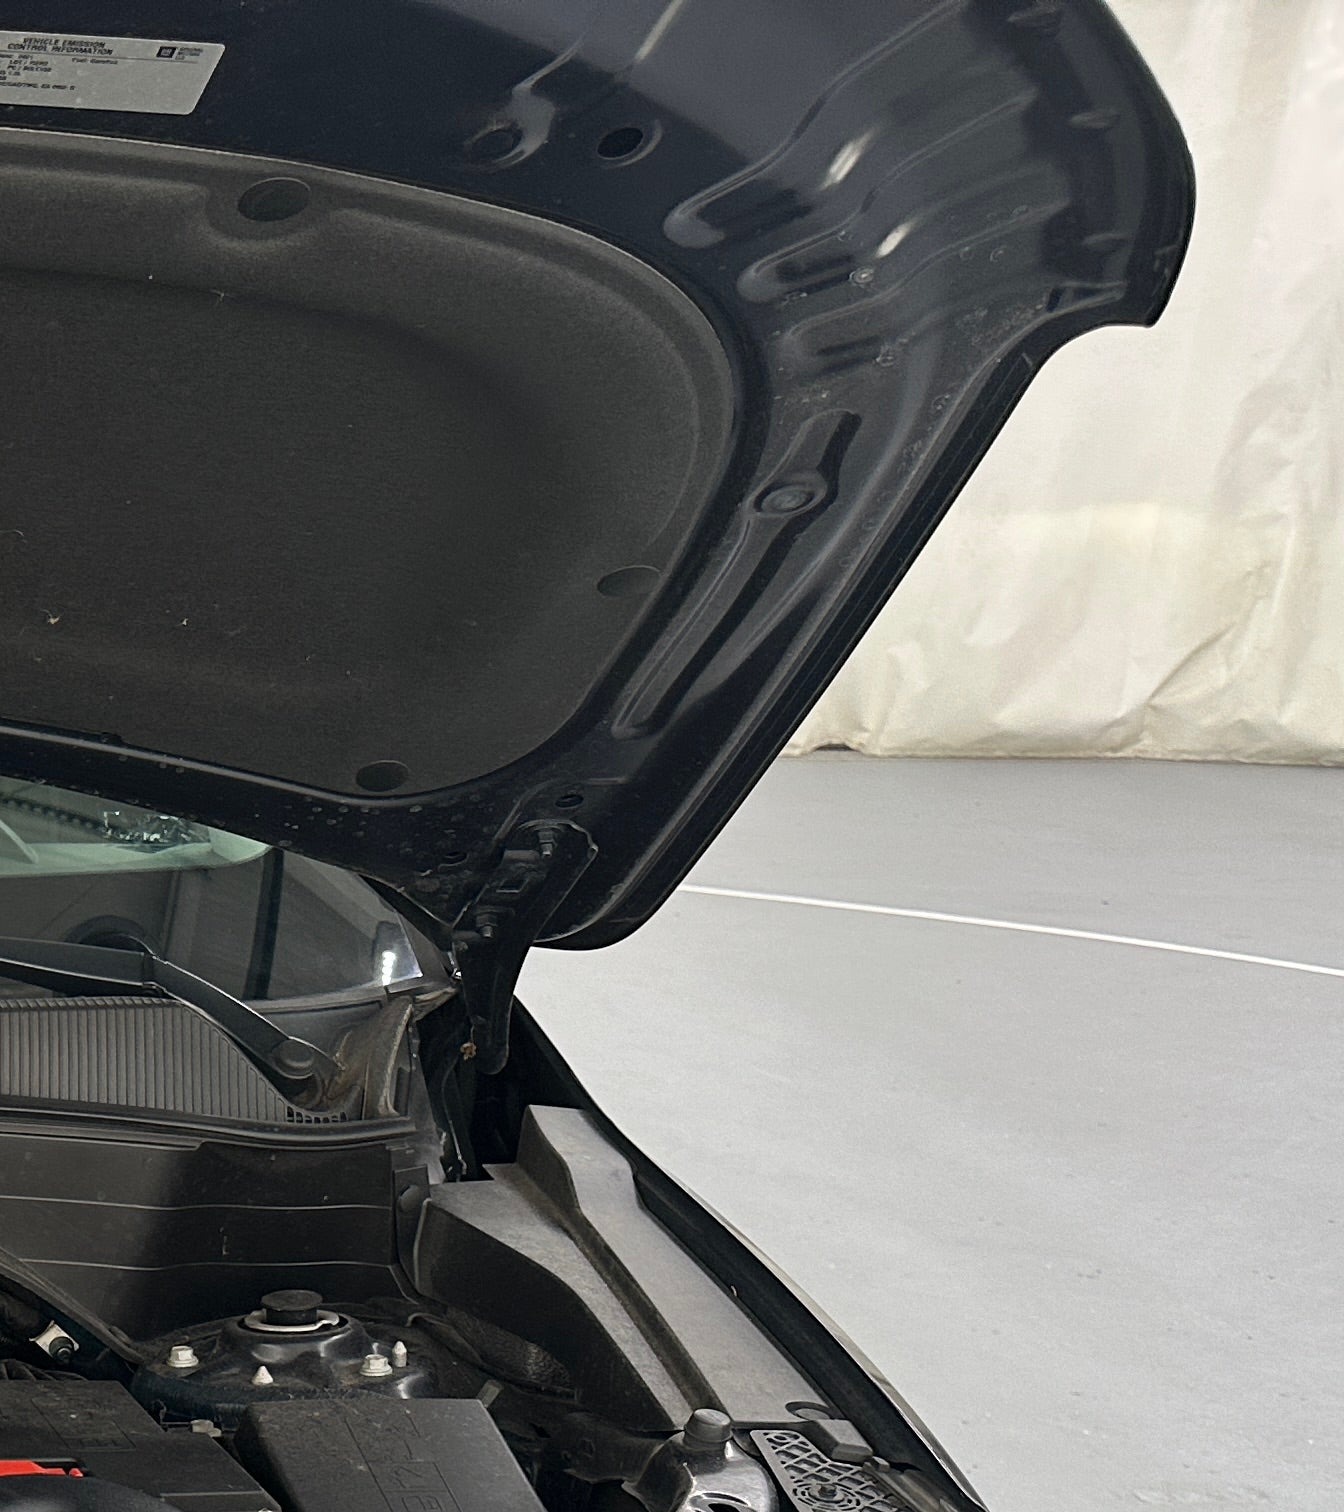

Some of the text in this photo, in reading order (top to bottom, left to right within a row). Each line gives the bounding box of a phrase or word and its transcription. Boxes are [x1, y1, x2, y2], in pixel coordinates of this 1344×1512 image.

[23, 37, 106, 49] VEHICLE EMISSION
[7, 43, 113, 56] CONTROL INFORMATION
